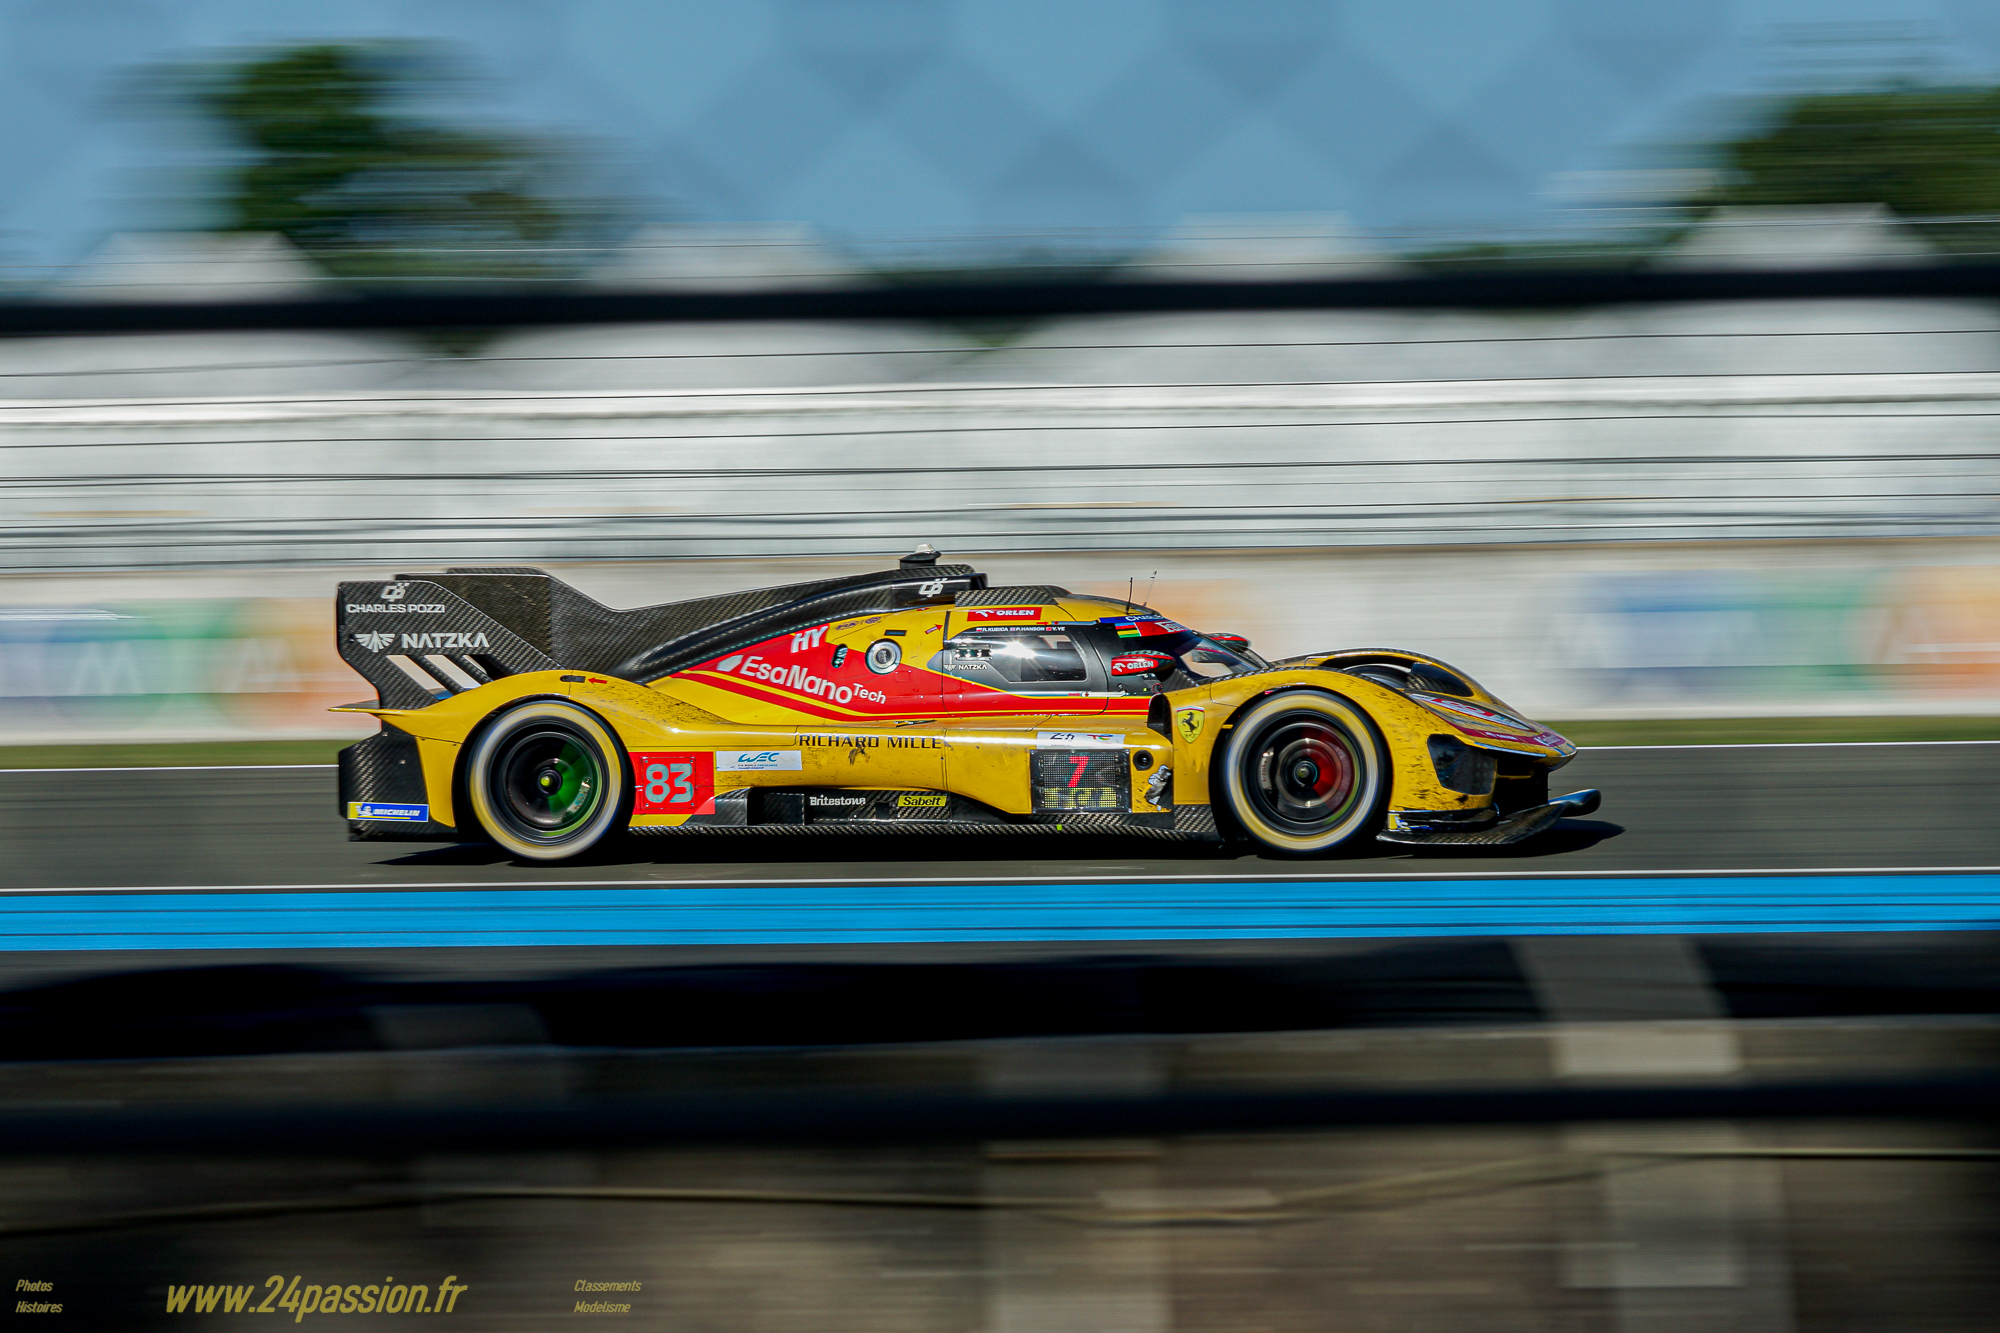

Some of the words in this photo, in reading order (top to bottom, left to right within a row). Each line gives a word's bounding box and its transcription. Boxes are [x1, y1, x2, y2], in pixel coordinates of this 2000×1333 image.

[346, 604, 407, 613] CHARLES
[408, 604, 446, 613] POZZI
[402, 632, 490, 649] NATZKA
[790, 625, 830, 654] HY
[1126, 660, 1154, 670] ORLEN
[739, 655, 853, 704] EsaNano
[853, 683, 887, 704] Tech
[799, 735, 880, 748] RICHARD
[887, 736, 942, 749] MILLE
[737, 752, 780, 763] WEC
[1068, 756, 1090, 788] 7
[645, 763, 694, 803] 83
[809, 794, 867, 806] Britestone
[903, 796, 942, 806] Sabelt
[373, 808, 421, 816] MICHELIN
